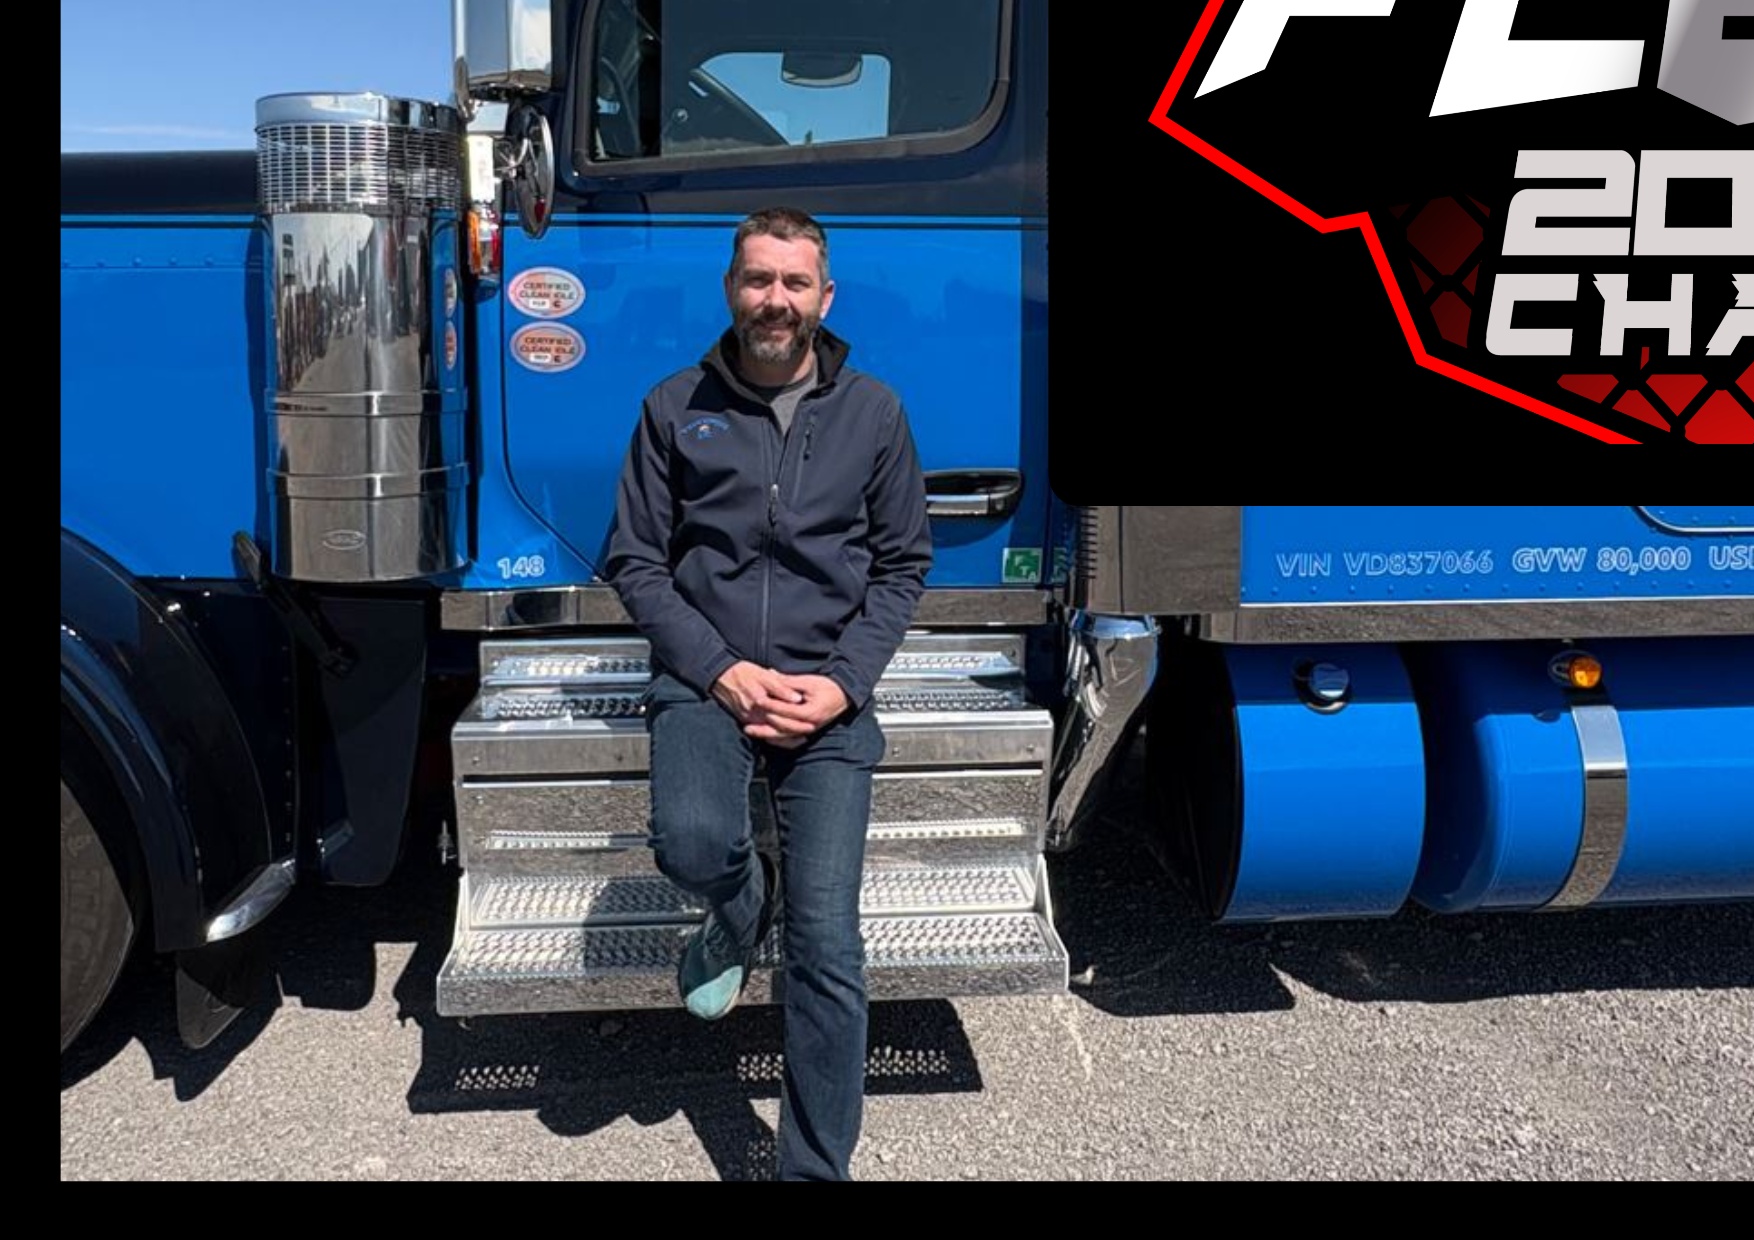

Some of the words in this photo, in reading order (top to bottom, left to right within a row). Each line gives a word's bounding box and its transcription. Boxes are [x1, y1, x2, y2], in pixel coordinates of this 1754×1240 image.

[497, 554, 545, 579] 148
[1275, 552, 1331, 578] VIN
[1344, 549, 1494, 576] VD837066
[1512, 546, 1588, 573] GVW
[1597, 546, 1692, 575] 80,000
